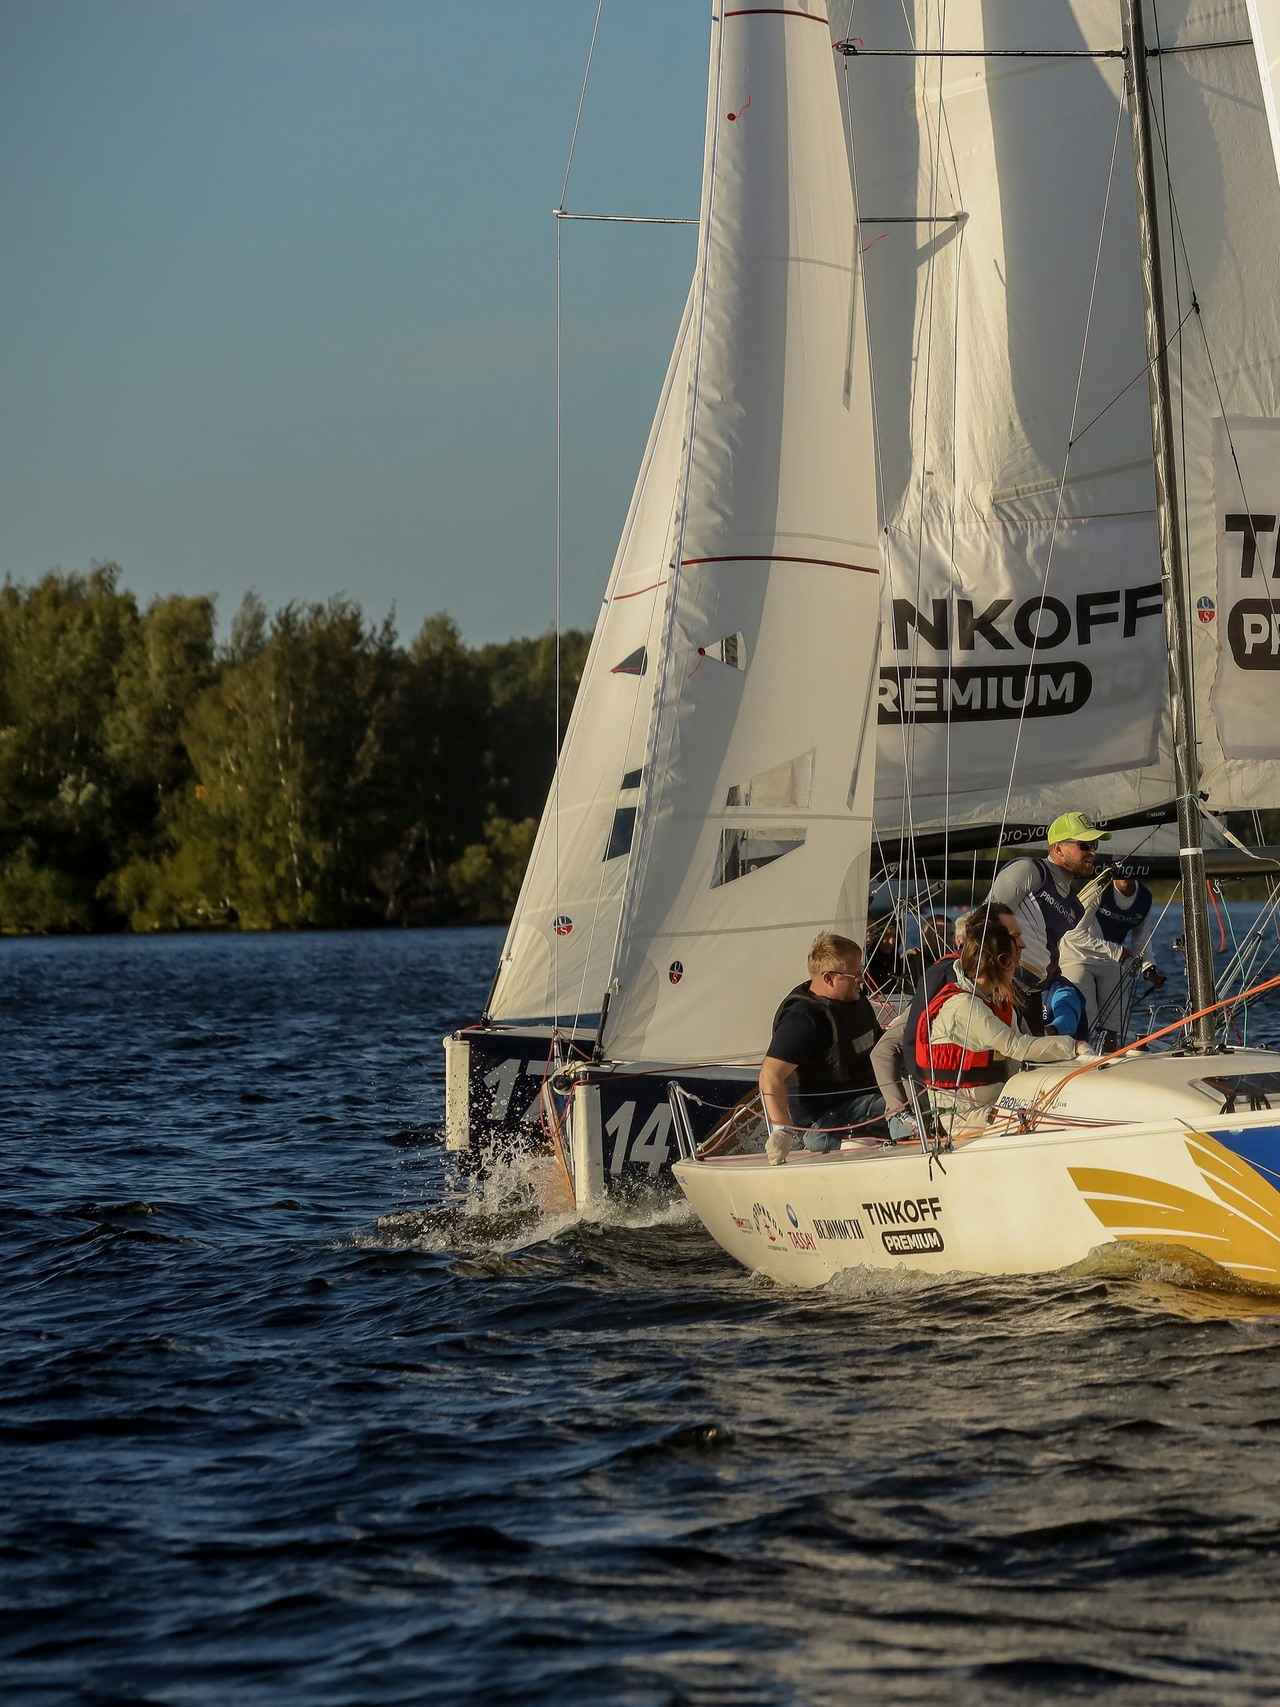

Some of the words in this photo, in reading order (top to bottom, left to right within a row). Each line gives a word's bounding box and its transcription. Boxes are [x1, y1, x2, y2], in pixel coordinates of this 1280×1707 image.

[891, 582, 1163, 650] NKOFF
[605, 1100, 671, 1175] 14
[862, 1197, 942, 1226] TINKOFF
[787, 1231, 817, 1251] TASSAY
[812, 1219, 865, 1240] ВЕДОМОСТИ
[884, 1231, 941, 1251] PREMIUM
